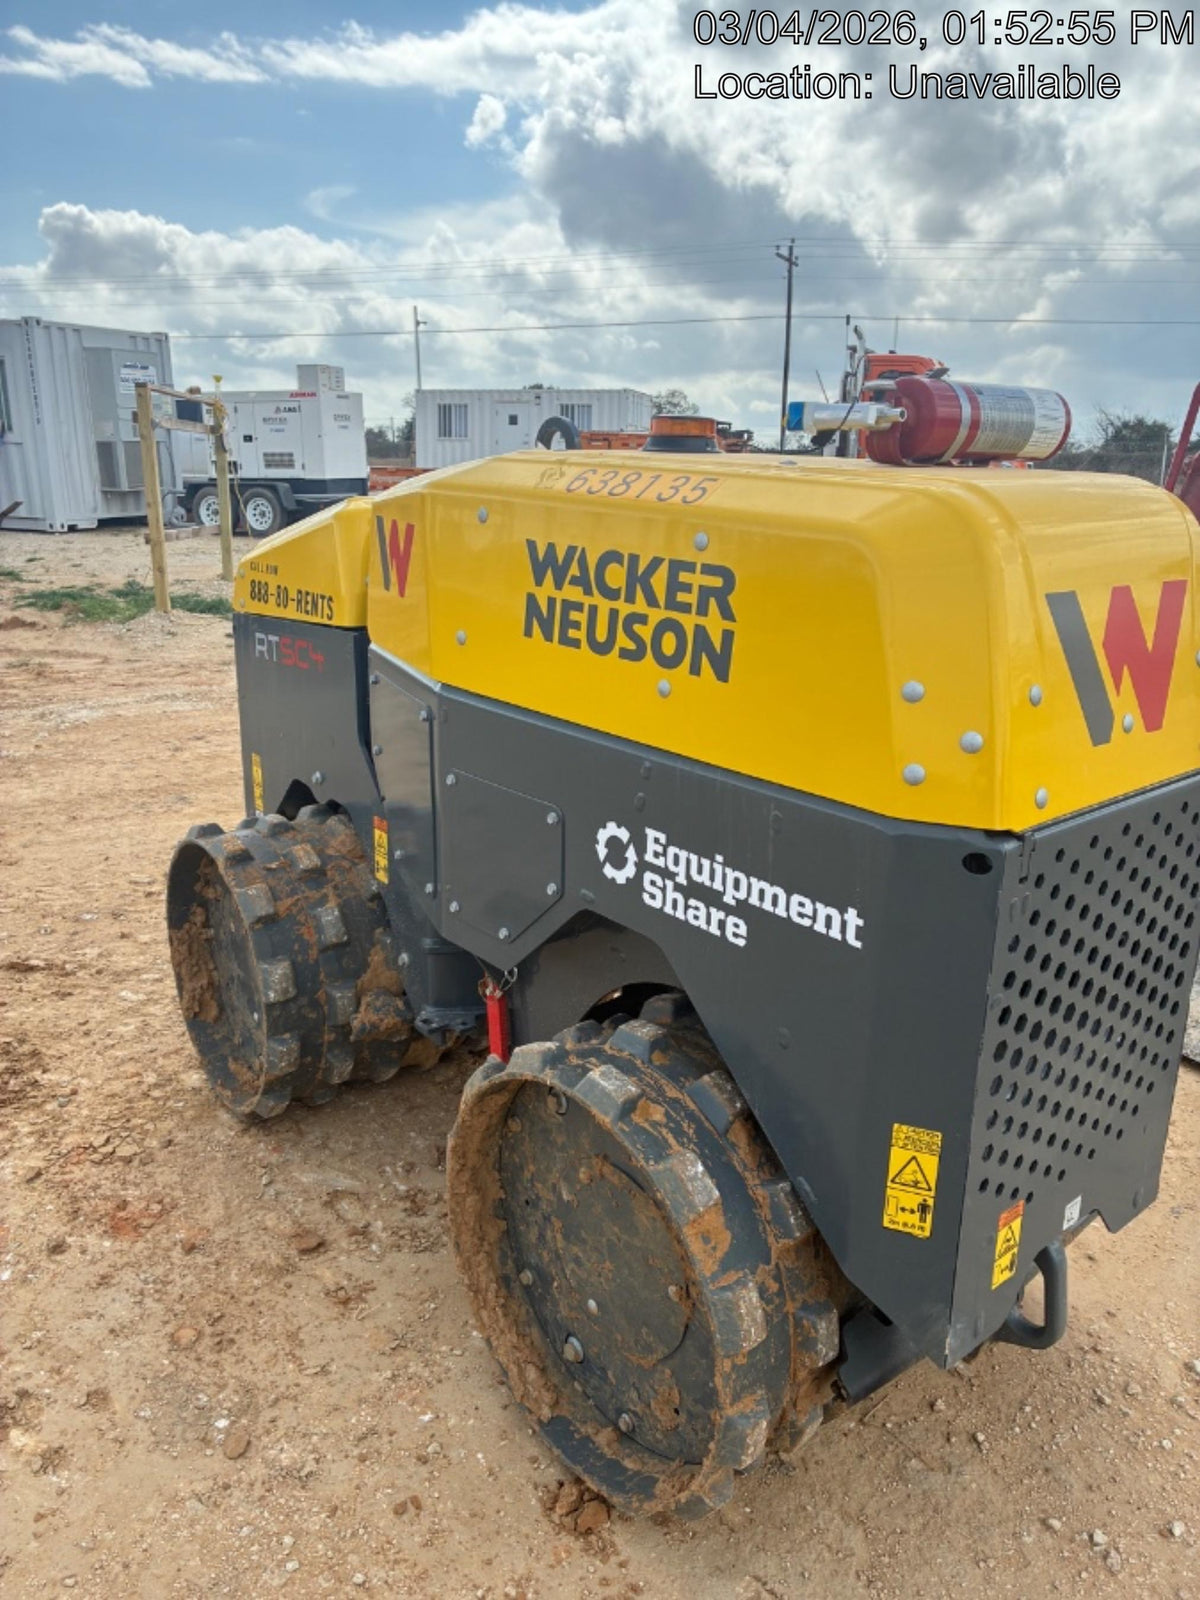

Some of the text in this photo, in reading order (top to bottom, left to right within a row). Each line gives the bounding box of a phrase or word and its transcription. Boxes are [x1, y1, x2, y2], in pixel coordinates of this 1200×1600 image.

[566, 468, 720, 504] 638135
[250, 579, 334, 621] 888-80-RENTS
[525, 538, 737, 623] WACKER
[523, 592, 735, 683] NEUSON
[641, 870, 748, 947] Share
[643, 826, 865, 949] Equipment
